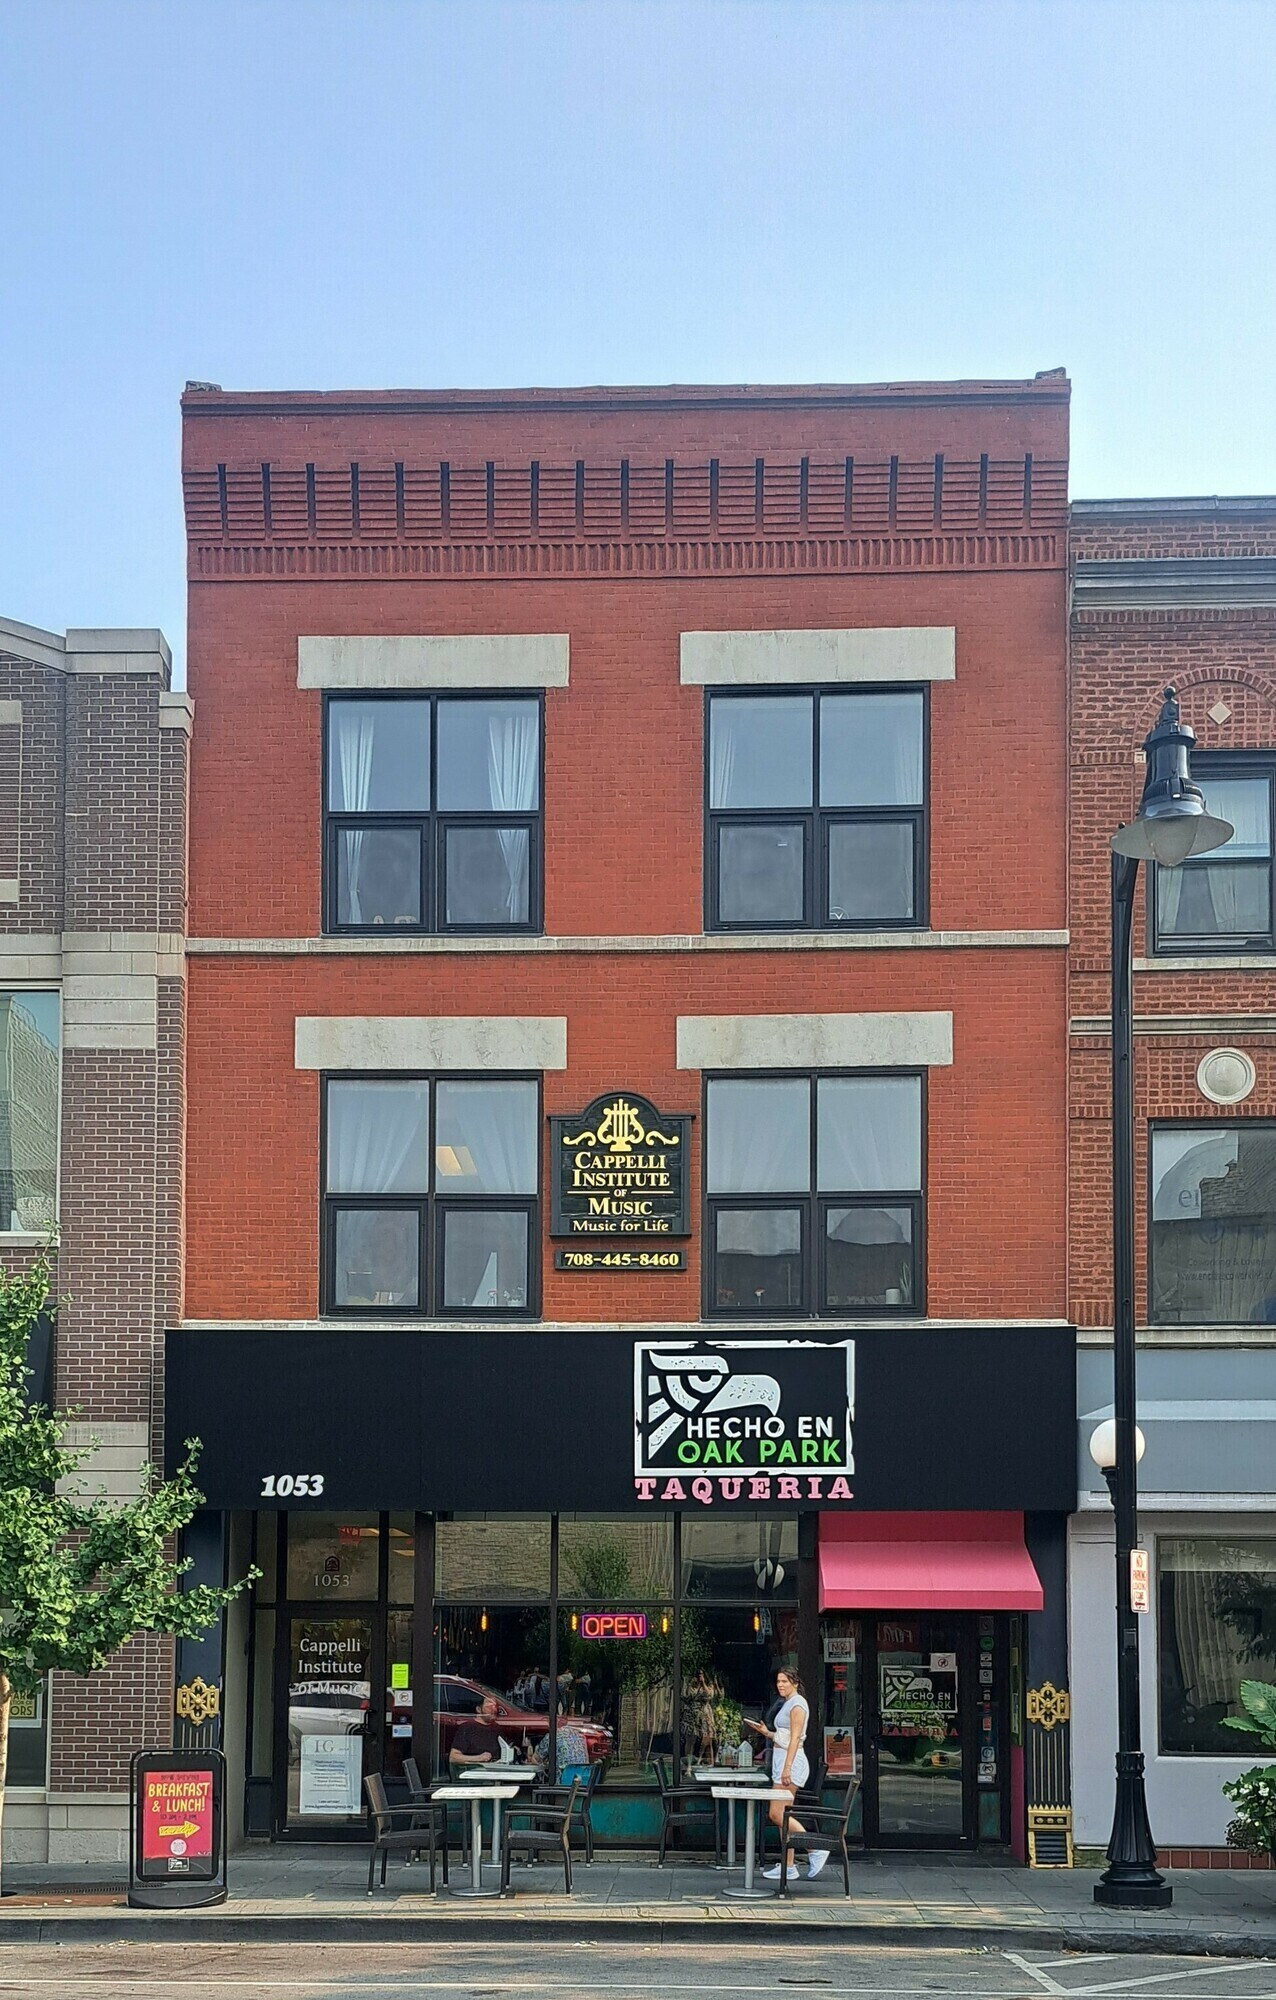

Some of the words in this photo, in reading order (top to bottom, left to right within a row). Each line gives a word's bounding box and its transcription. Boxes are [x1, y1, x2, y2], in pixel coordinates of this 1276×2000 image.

[575, 1152, 666, 1169] CAPPELLI
[572, 1169, 670, 1186] INSTITUTE
[588, 1197, 653, 1215] MUSIC
[573, 1220, 616, 1232] Music
[620, 1220, 640, 1232] for
[644, 1220, 669, 1232] Life
[564, 1253, 679, 1267] 708-445-8460
[687, 1416, 785, 1438] HECHO
[798, 1416, 833, 1438] EN
[677, 1440, 744, 1463] OAK
[760, 1439, 842, 1463] PARK
[260, 1474, 325, 1497] 1053
[634, 1477, 854, 1504] TAQUERIA
[314, 1574, 350, 1587] 1053
[585, 1617, 643, 1636] OPEN
[300, 1638, 361, 1655] Cappelli
[298, 1660, 362, 1673] Institute
[298, 1681, 313, 1694] of
[317, 1681, 361, 1695] Music
[900, 1691, 934, 1700] HECHO
[938, 1692, 951, 1700] EN
[148, 1782, 210, 1797] BREAKFAST
[151, 1800, 161, 1812] &
[166, 1796, 206, 1812] LUNCH!
